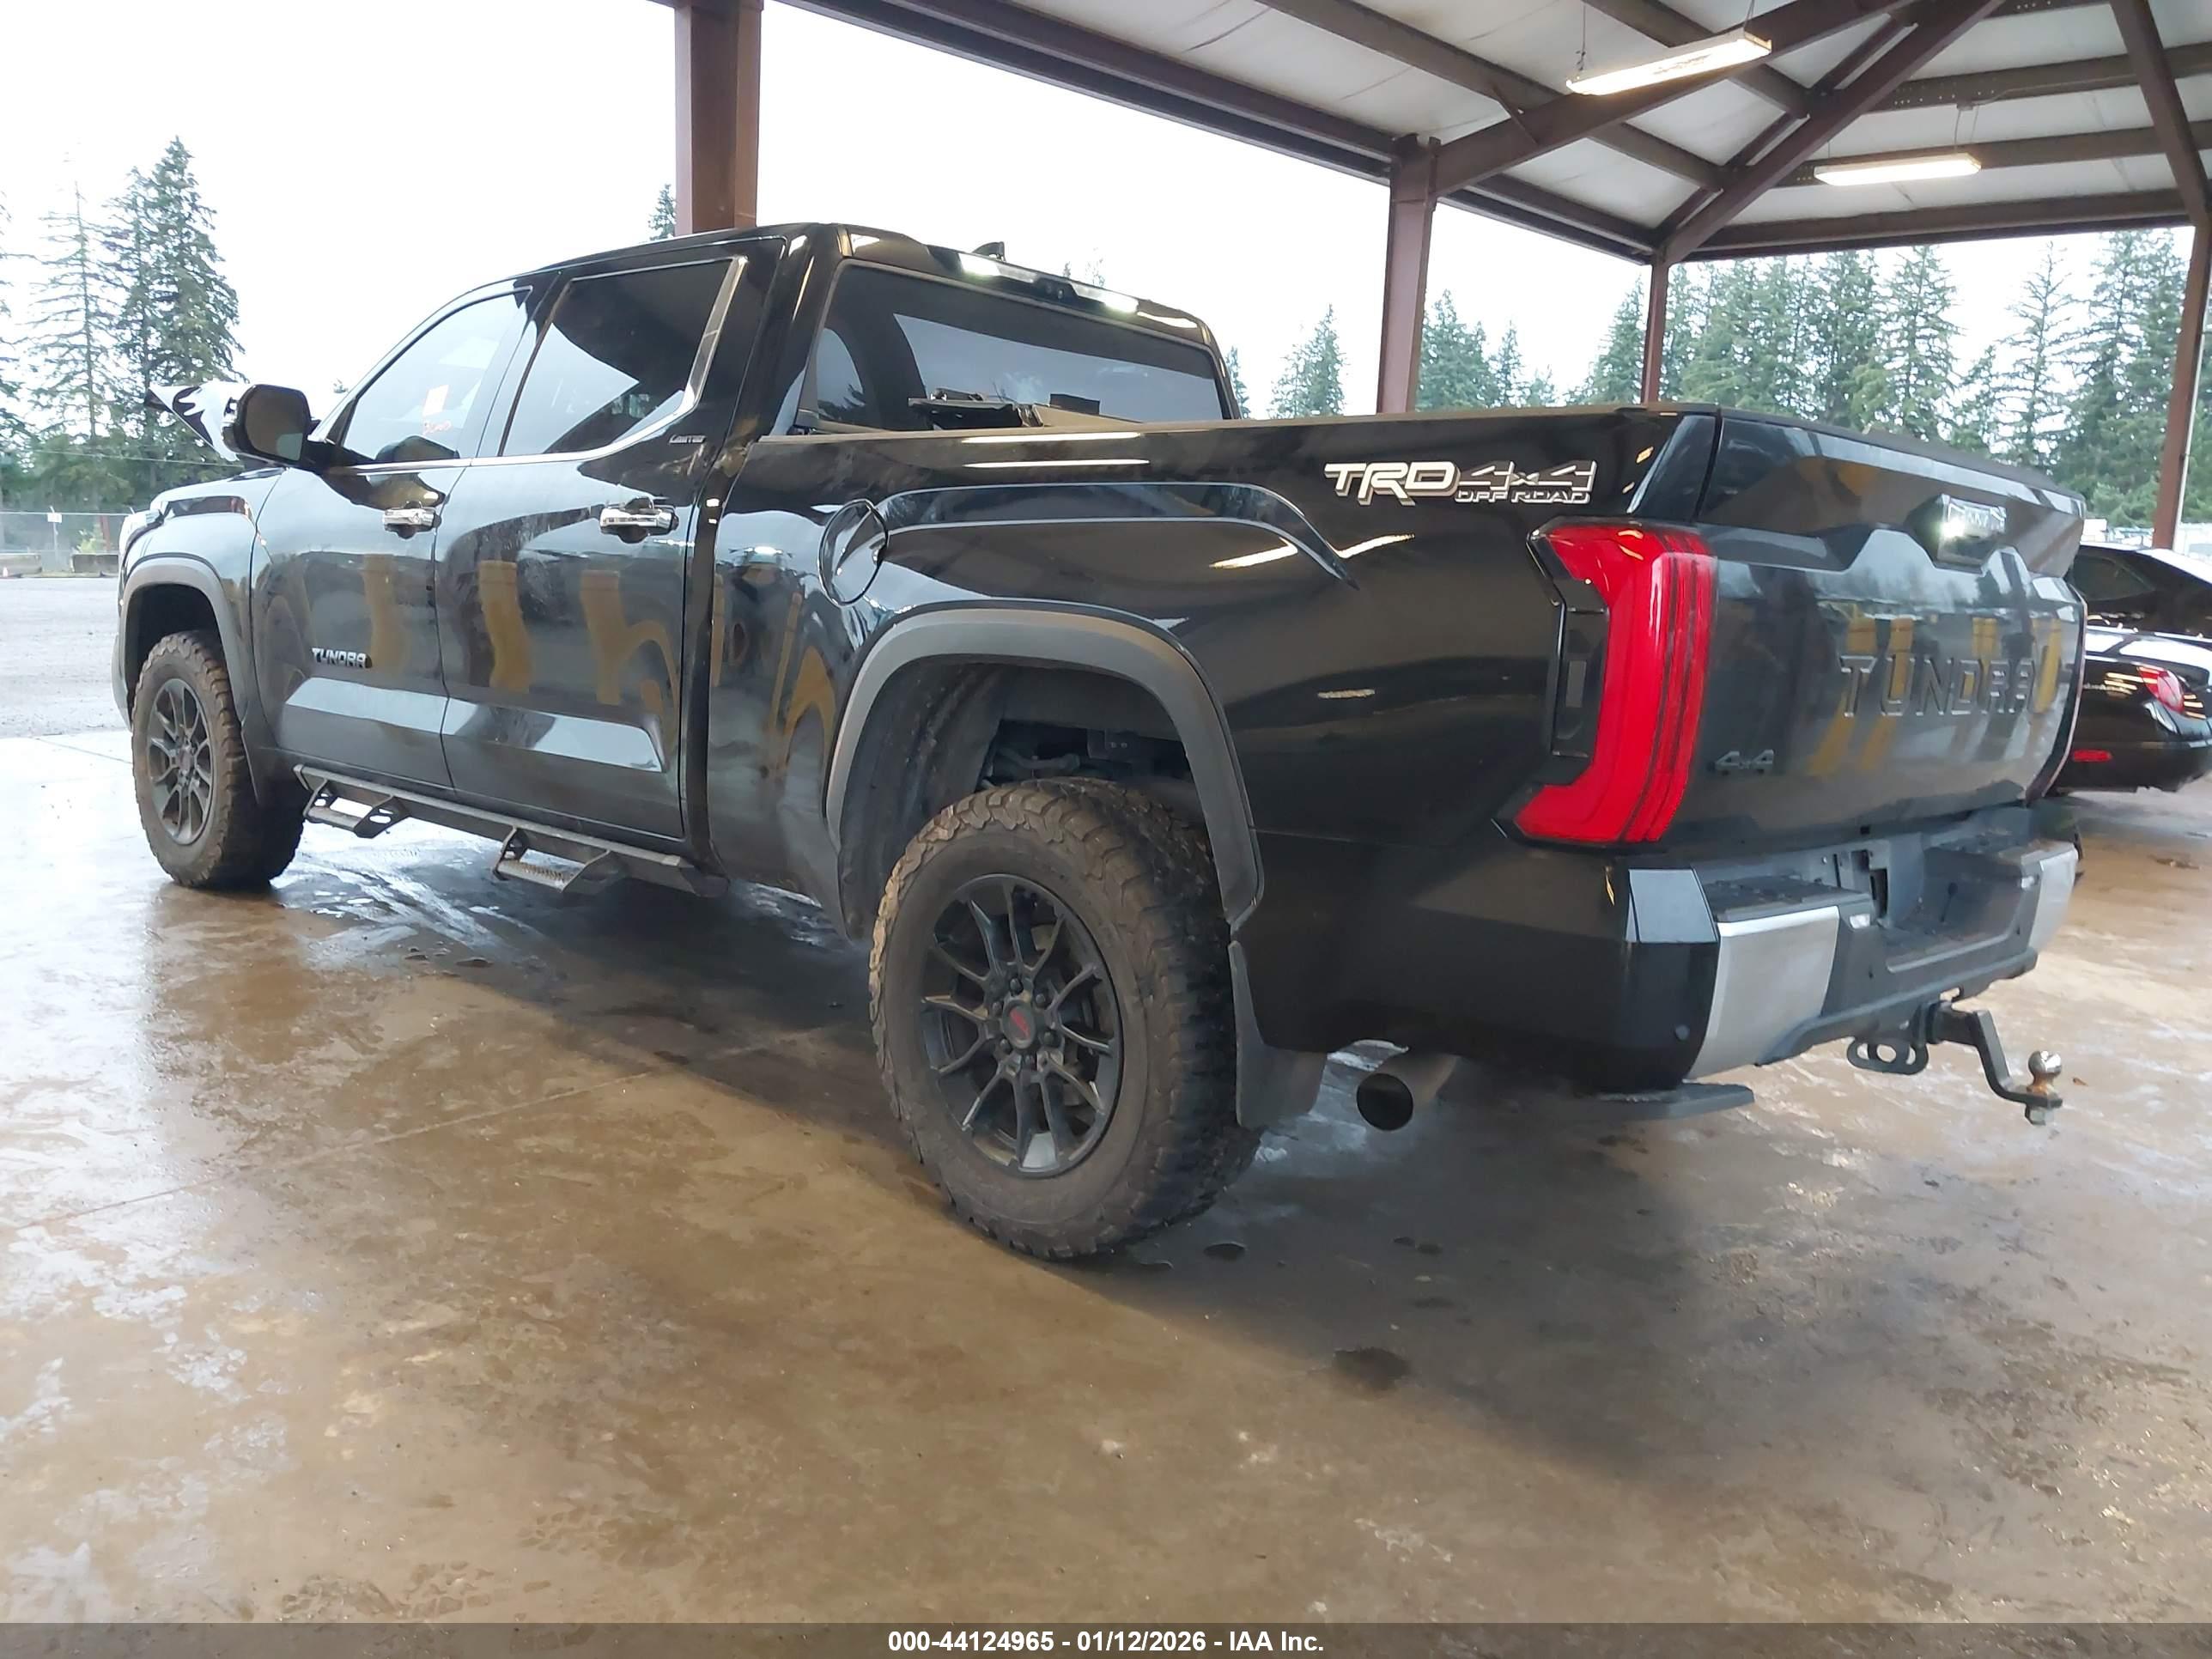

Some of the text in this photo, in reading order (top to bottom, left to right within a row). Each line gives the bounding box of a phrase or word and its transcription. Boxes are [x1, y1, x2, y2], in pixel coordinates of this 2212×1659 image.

[1323, 459, 1597, 507] TRD 4x4
[1455, 489, 1591, 505] OFF ROAD
[311, 647, 368, 669] TUNDRA
[1839, 654, 2037, 718] TUNDRA
[1715, 749, 1775, 771] 4x4
